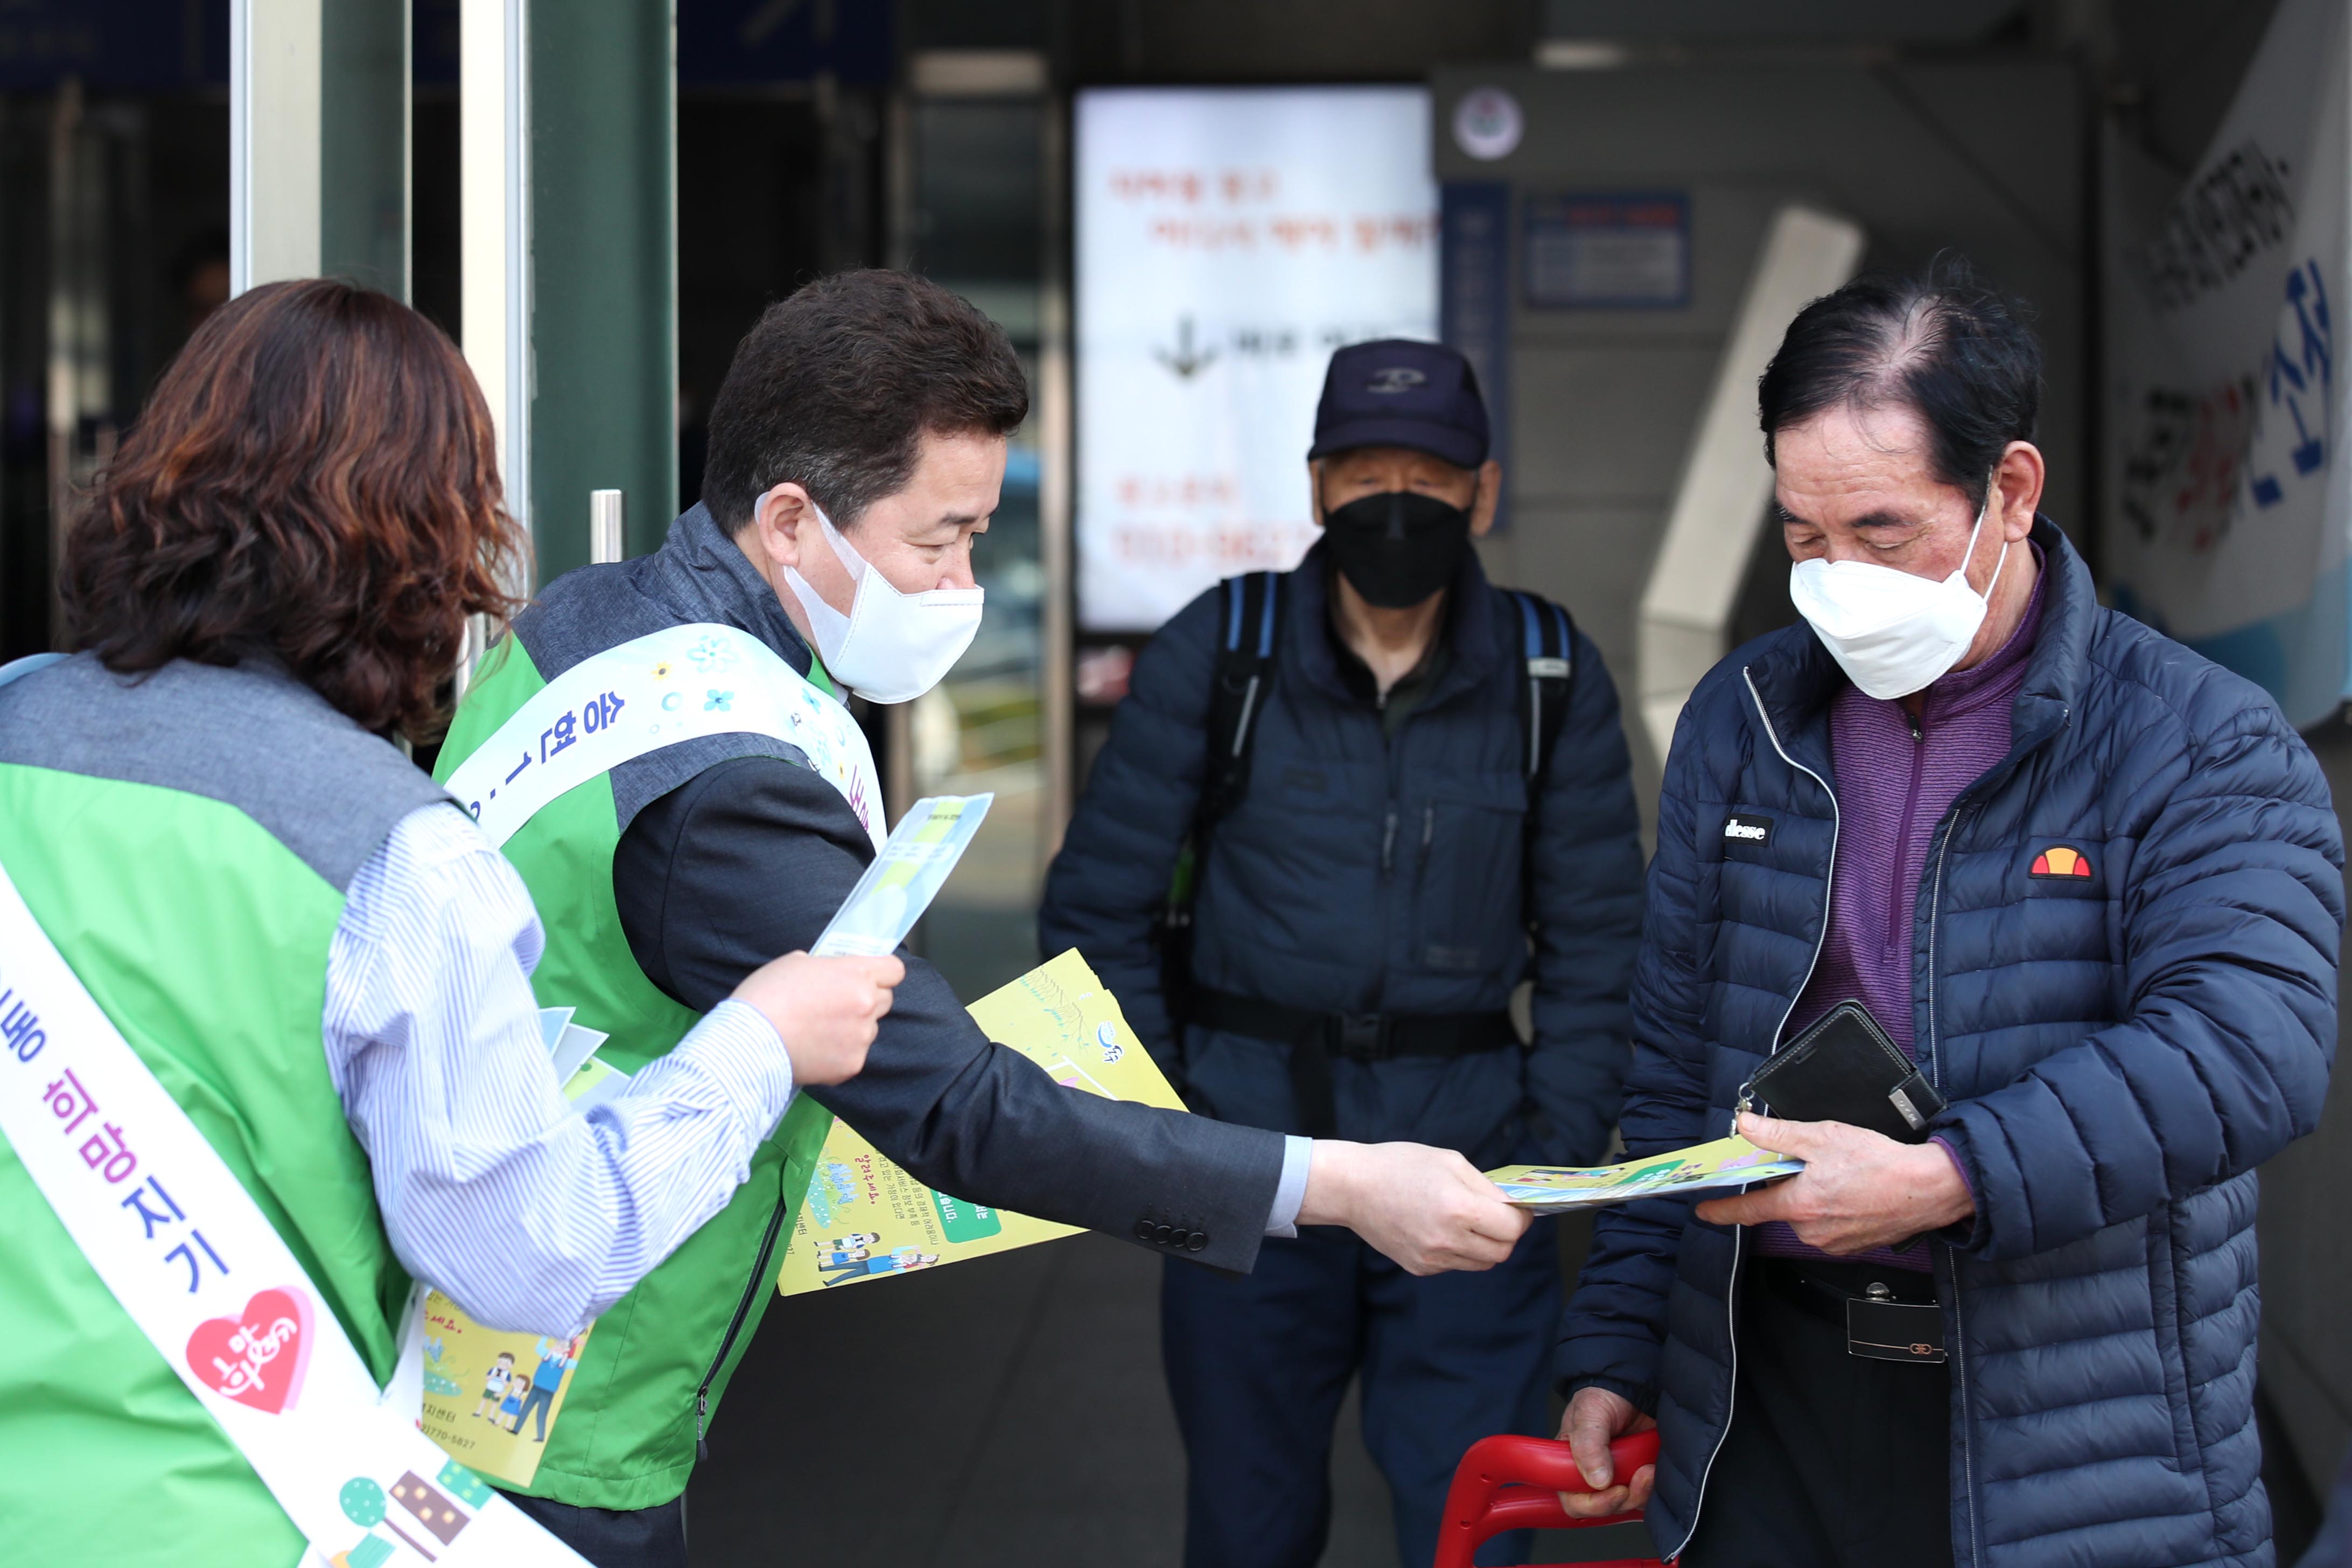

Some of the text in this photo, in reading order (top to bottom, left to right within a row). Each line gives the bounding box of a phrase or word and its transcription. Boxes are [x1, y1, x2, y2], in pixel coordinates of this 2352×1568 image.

[43, 1067, 230, 1293] 희망지기
[855, 1154, 879, 1205] 알려주세요.
[882, 1169, 892, 1181] 있는
[886, 1184, 899, 1201] 가정이
[902, 1194, 912, 1206] 정보
[892, 1202, 905, 1219] 있다면
[973, 1203, 989, 1220] 서는
[923, 1219, 940, 1245] 어려움이나
